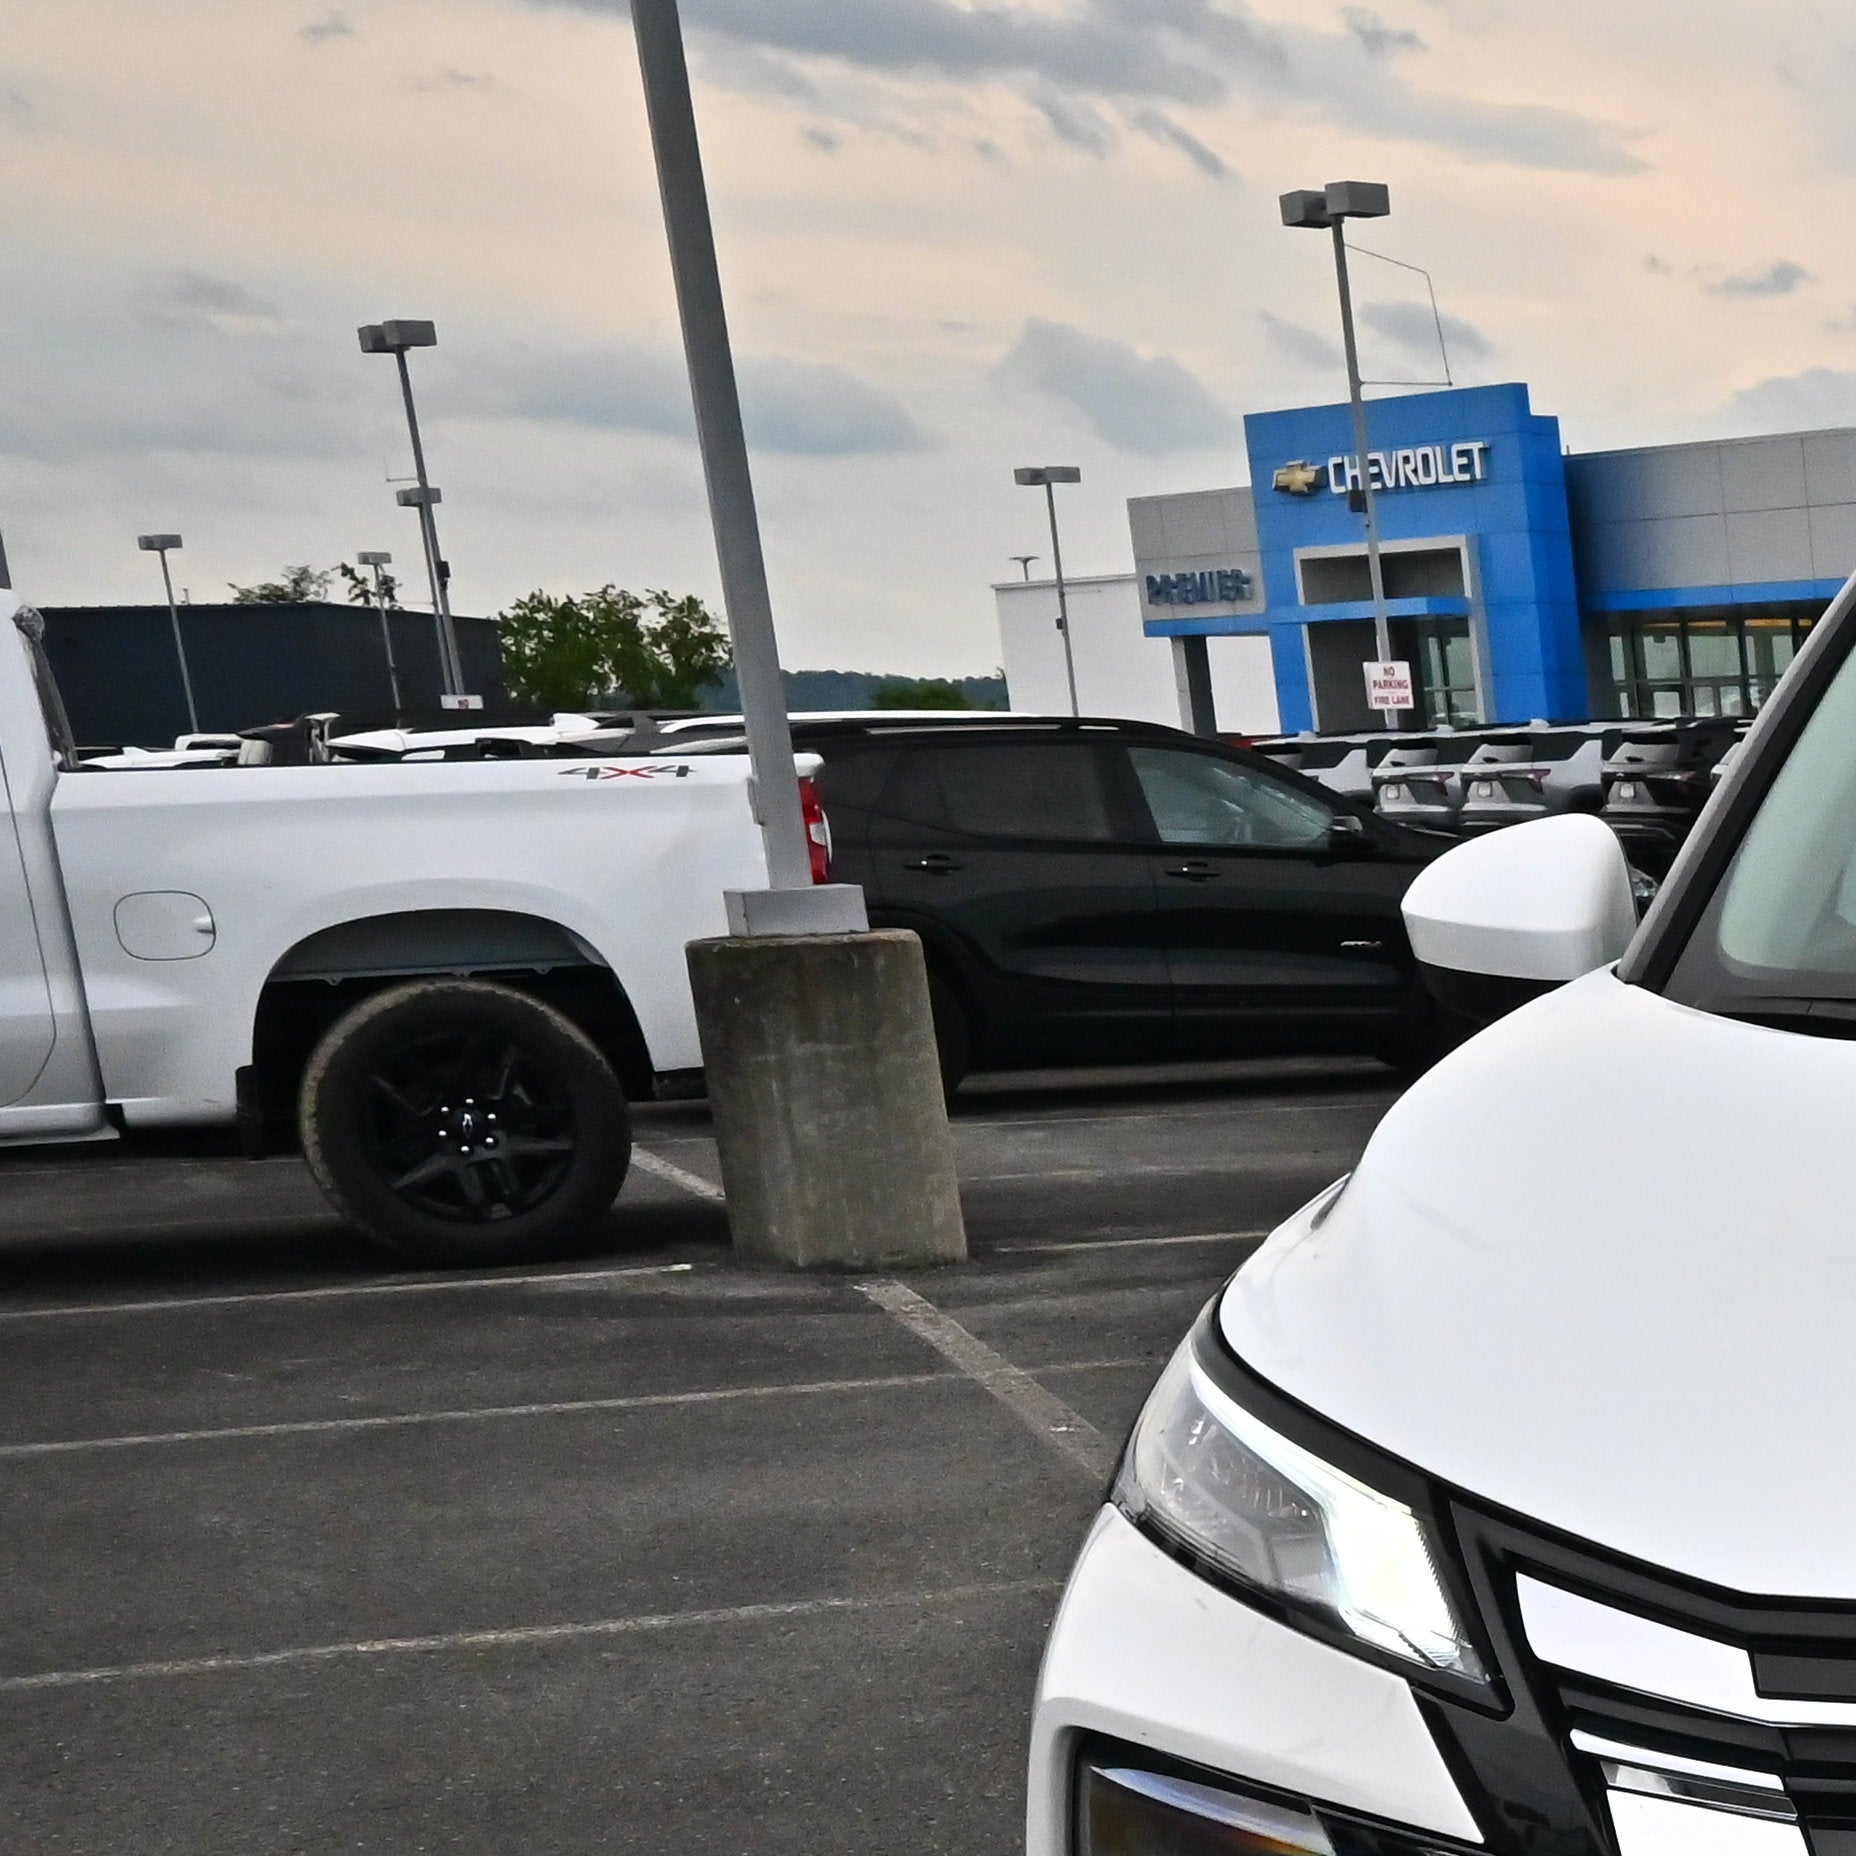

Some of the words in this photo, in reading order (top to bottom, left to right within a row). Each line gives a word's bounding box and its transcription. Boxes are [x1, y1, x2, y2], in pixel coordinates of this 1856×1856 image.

[1328, 441, 1485, 494] CHEVROLET
[1383, 666, 1396, 677] NO
[1372, 679, 1409, 689] PARKING
[1374, 696, 1390, 705] FIRE
[1391, 695, 1410, 705] LANE
